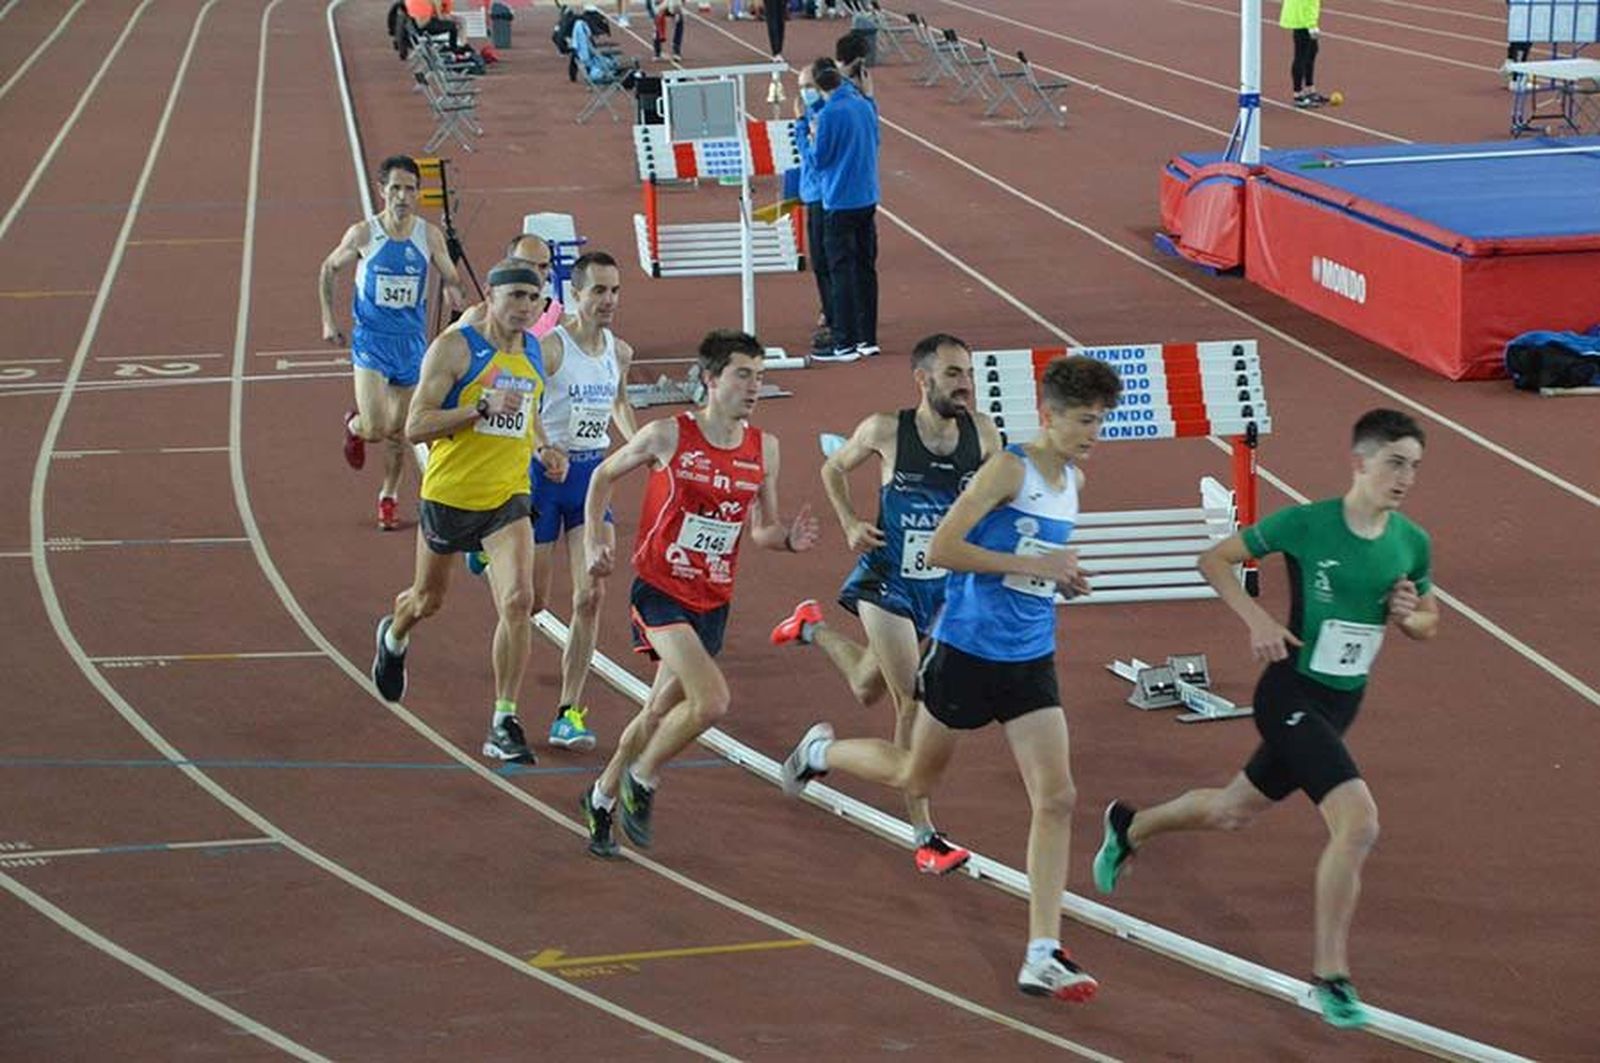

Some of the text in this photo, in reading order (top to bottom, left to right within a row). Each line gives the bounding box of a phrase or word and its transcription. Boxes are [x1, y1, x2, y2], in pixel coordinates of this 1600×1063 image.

[1322, 257, 1366, 304] MONDO
[383, 287, 412, 302] 3471
[1104, 409, 1154, 422] ONDO
